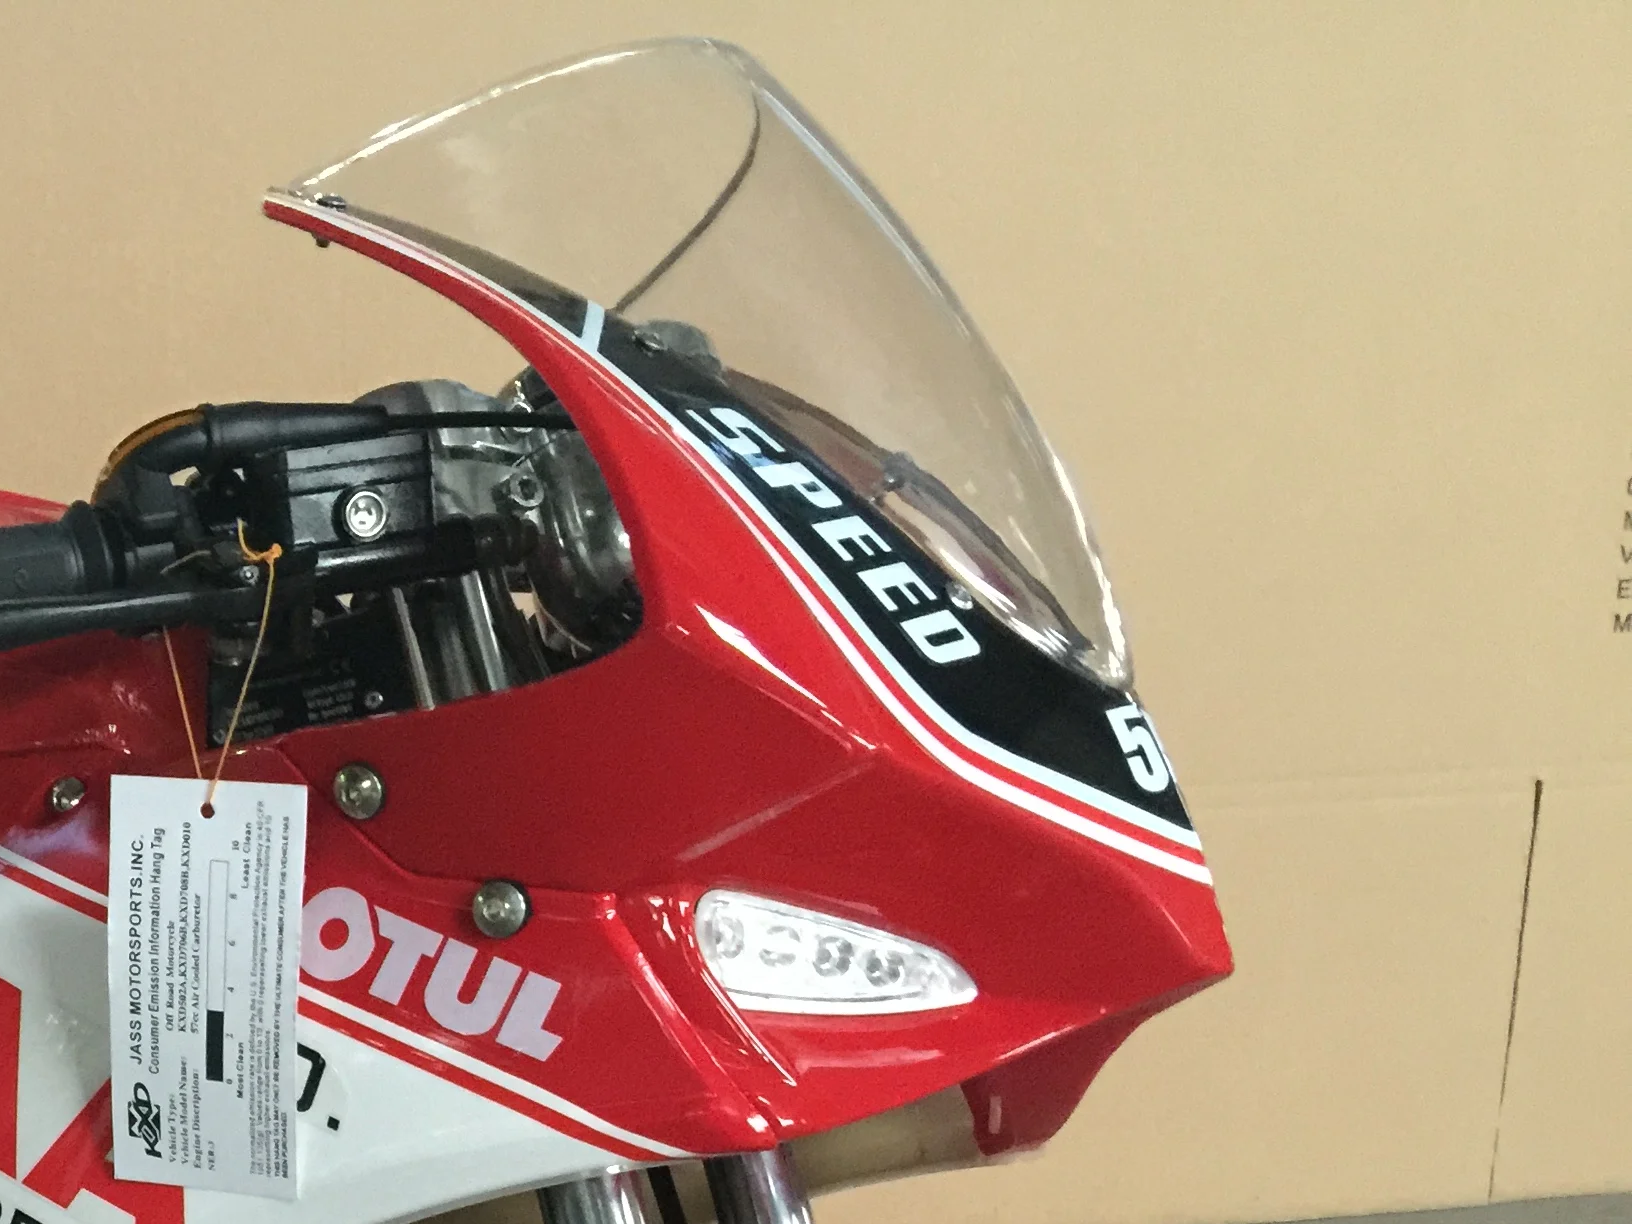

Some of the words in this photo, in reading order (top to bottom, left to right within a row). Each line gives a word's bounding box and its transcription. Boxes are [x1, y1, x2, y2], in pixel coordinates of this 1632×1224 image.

[686, 406, 981, 665] SPEED
[150, 828, 165, 849] Tag
[150, 852, 165, 884] Hang
[148, 886, 160, 955] Information
[166, 920, 176, 977] Motorcycle
[299, 887, 563, 1062] OTUL
[147, 958, 160, 1012] Emission
[166, 982, 174, 1009] Road
[129, 1020, 142, 1065] JASS
[148, 1015, 160, 1074] Consumer
[166, 1013, 174, 1031] Off
